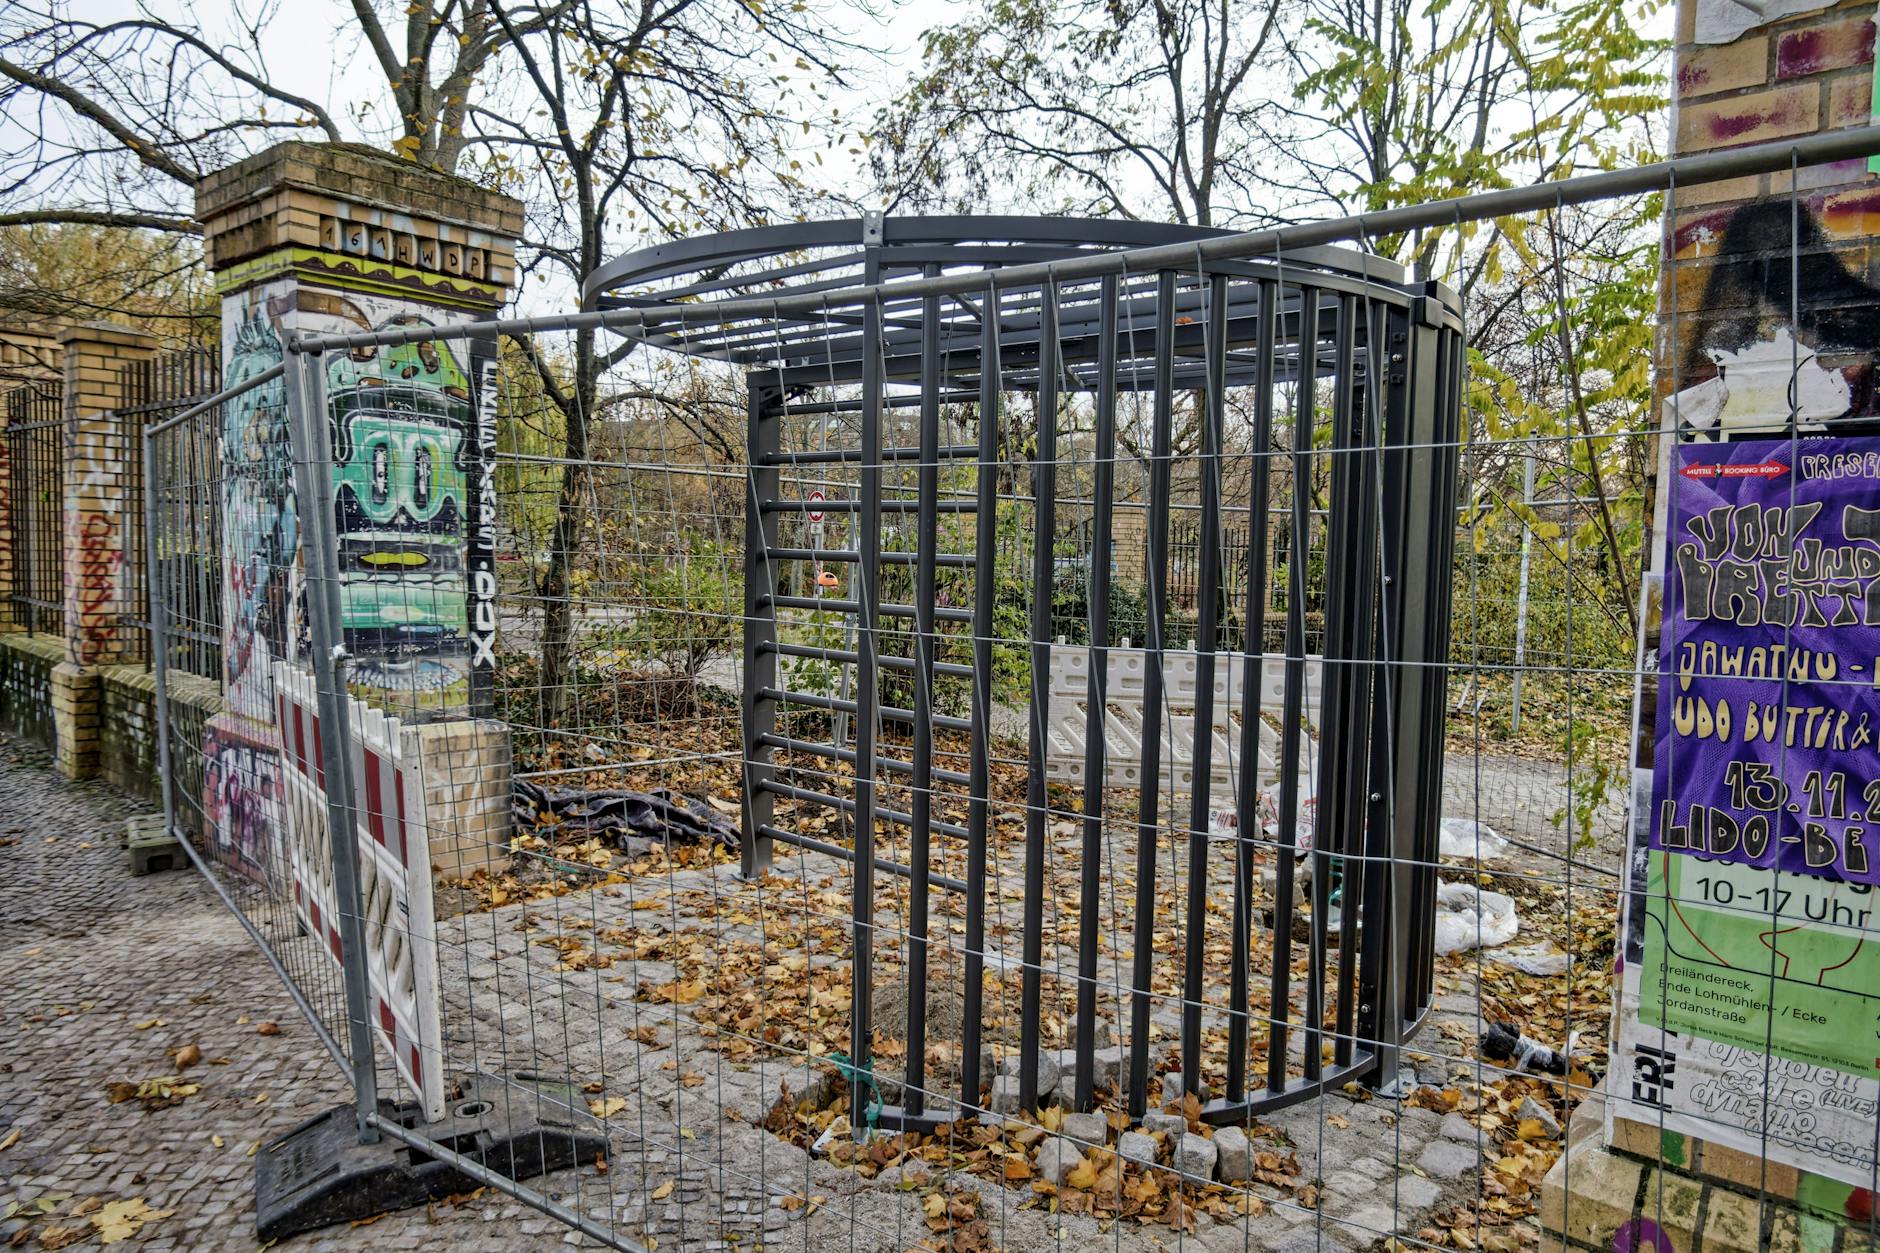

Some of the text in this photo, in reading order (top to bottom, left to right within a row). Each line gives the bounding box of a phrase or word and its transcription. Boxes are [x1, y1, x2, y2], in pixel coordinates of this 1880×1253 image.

[1724, 466, 1759, 475] BOOKING
[1759, 465, 1781, 474] BÜRO
[1802, 452, 1880, 480] PRESE
[1686, 502, 1823, 561] VON
[1791, 538, 1880, 582] UND
[1674, 696, 1732, 743] UDO
[1804, 894, 1872, 928] Uhr
[1657, 994, 1747, 1025] Jordanstraße
[1658, 978, 1691, 995] Ende
[1695, 986, 1778, 1013] Lohmühlen-
[1792, 1008, 1828, 1025] Ecke
[1819, 1088, 1879, 1119] (LIVE)
